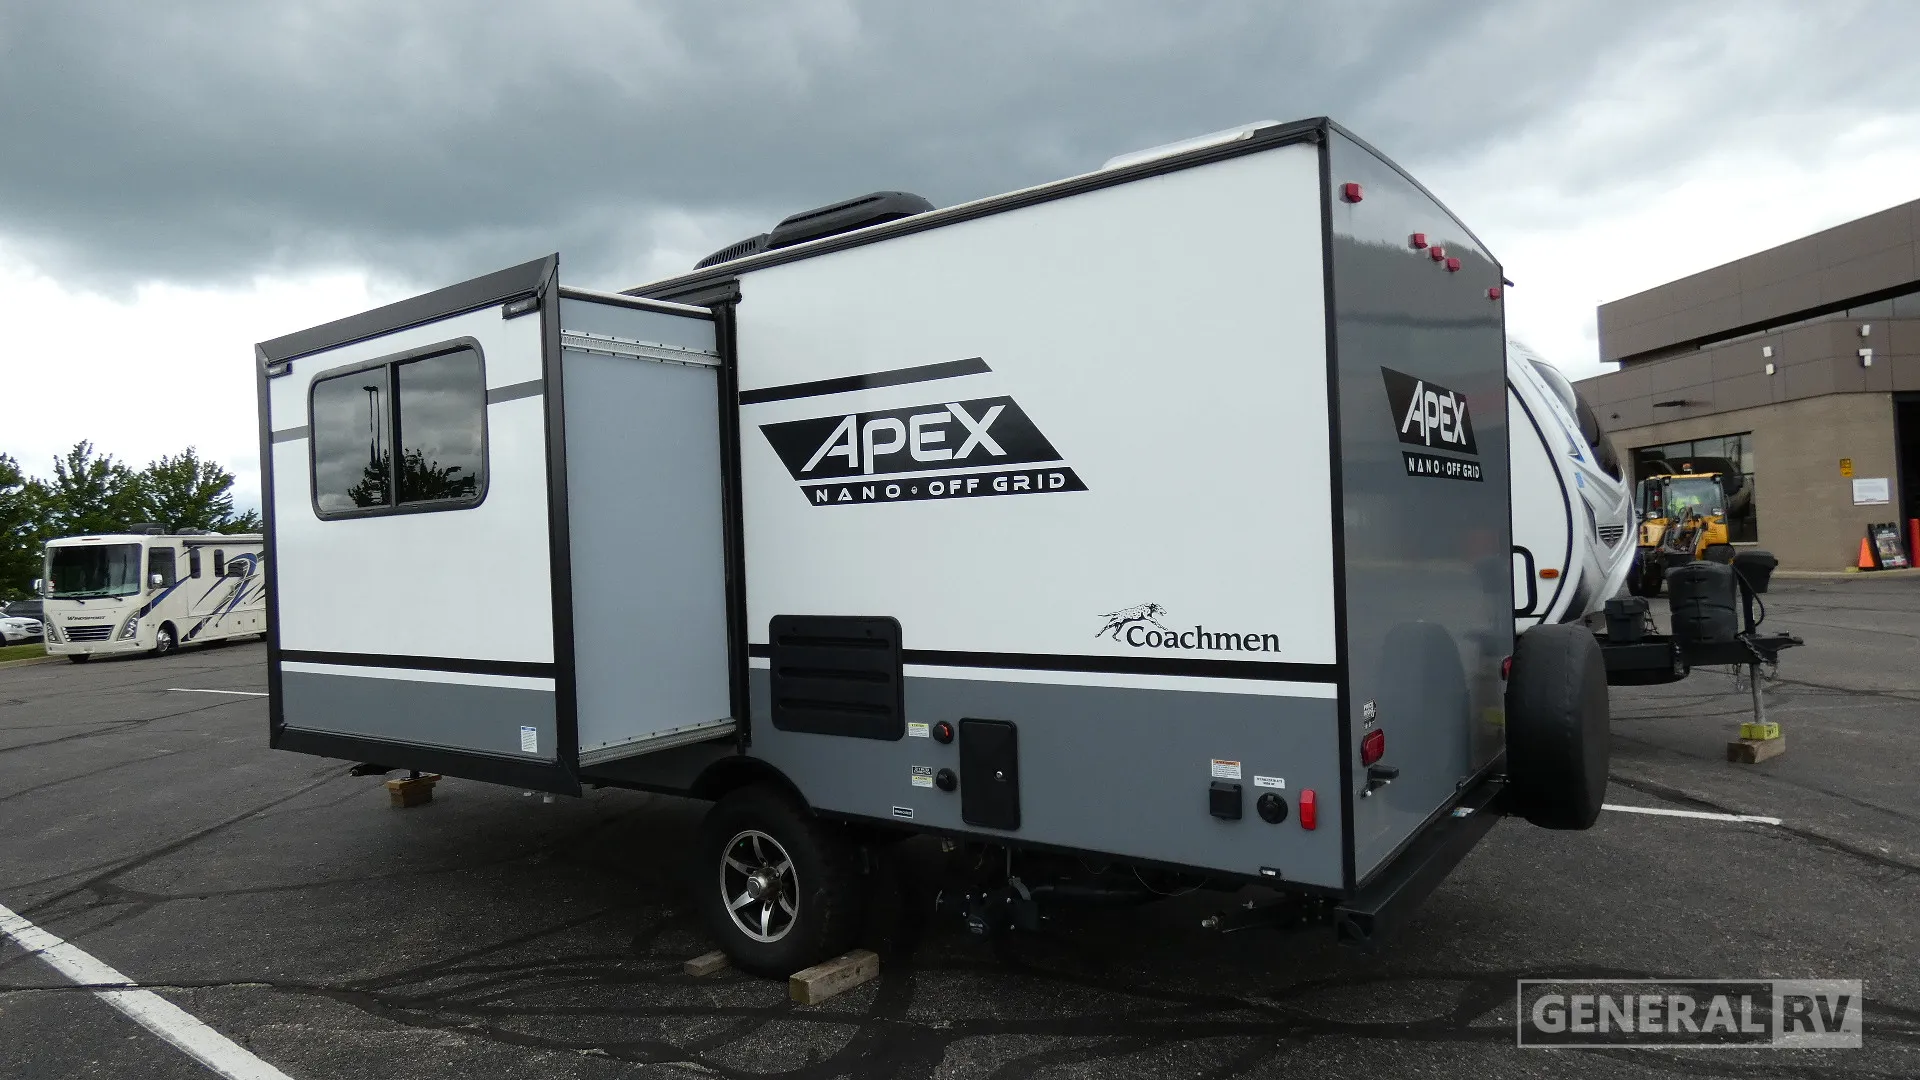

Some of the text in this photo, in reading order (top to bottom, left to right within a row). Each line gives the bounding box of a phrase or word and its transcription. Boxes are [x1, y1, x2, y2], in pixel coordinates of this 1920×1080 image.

[1401, 380, 1467, 447] APEX
[800, 402, 1007, 475] APEX
[1408, 457, 1480, 479] NANO OFF GRID
[815, 472, 1067, 503] NANO OFF GRID
[1126, 624, 1282, 653] Coachmen
